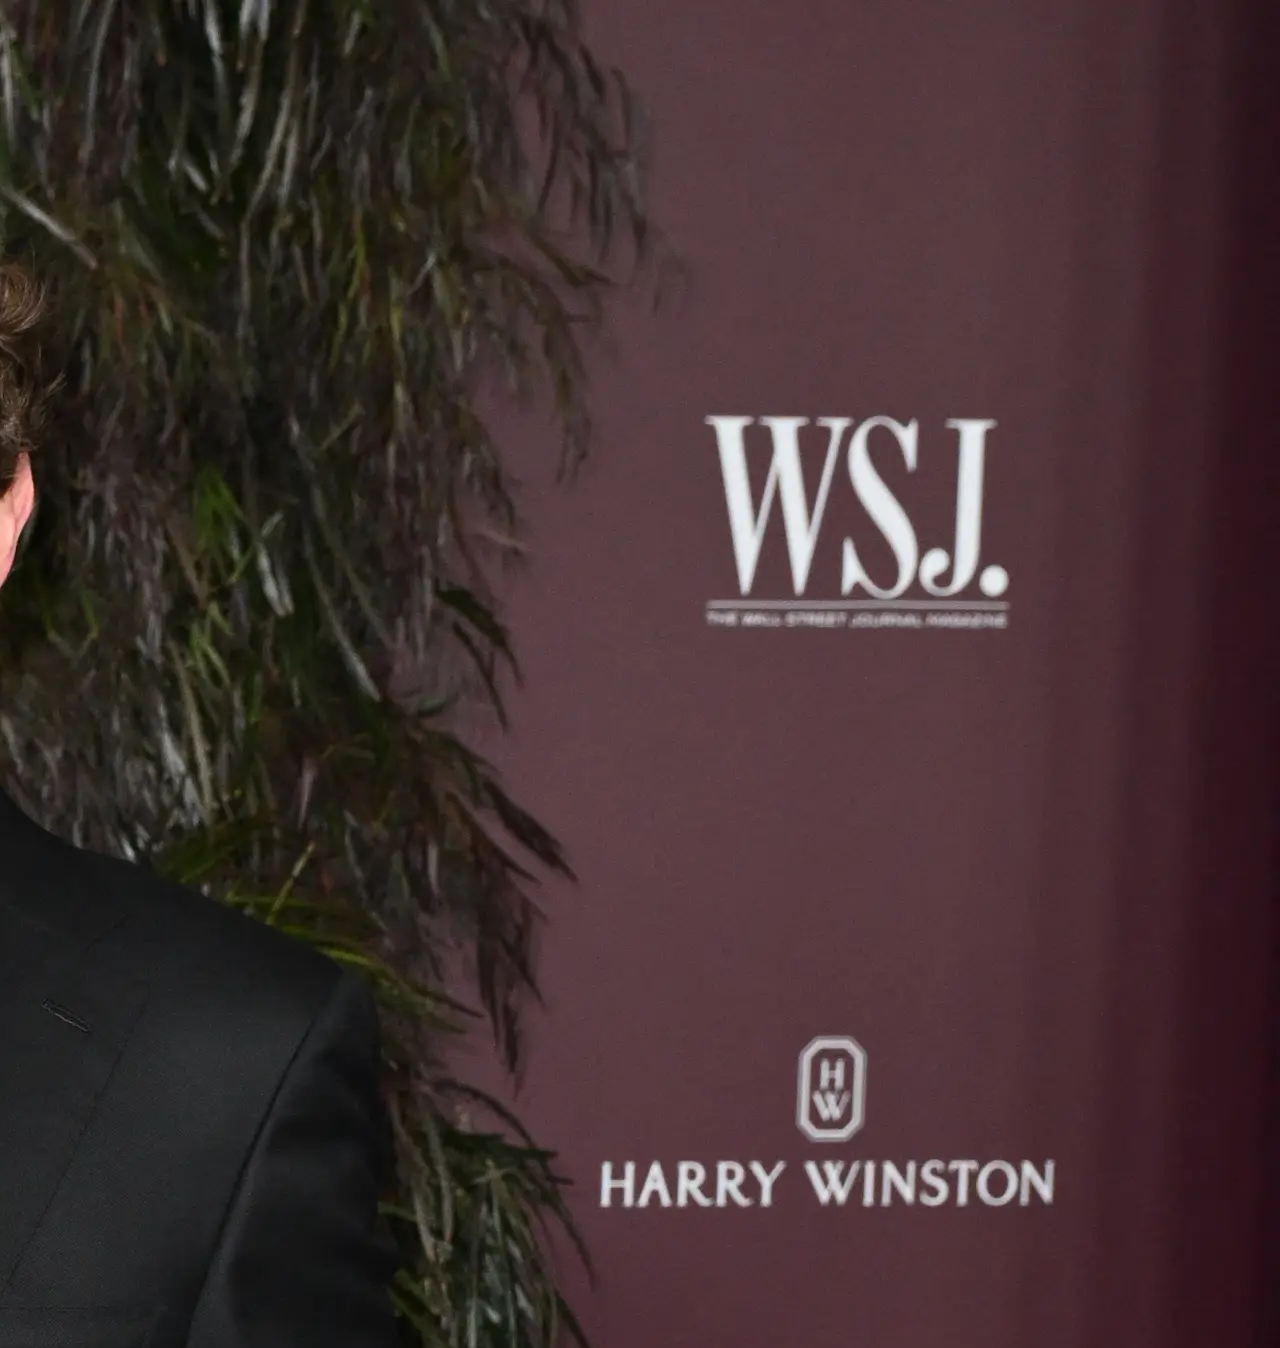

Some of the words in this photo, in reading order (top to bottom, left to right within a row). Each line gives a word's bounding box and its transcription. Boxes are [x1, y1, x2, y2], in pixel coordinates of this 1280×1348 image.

[705, 414, 1010, 600] WSJ.
[706, 612, 737, 628] THE
[785, 612, 847, 628] STREET
[599, 1160, 788, 1208] HARRY
[804, 1159, 1056, 1207] WINSTON
